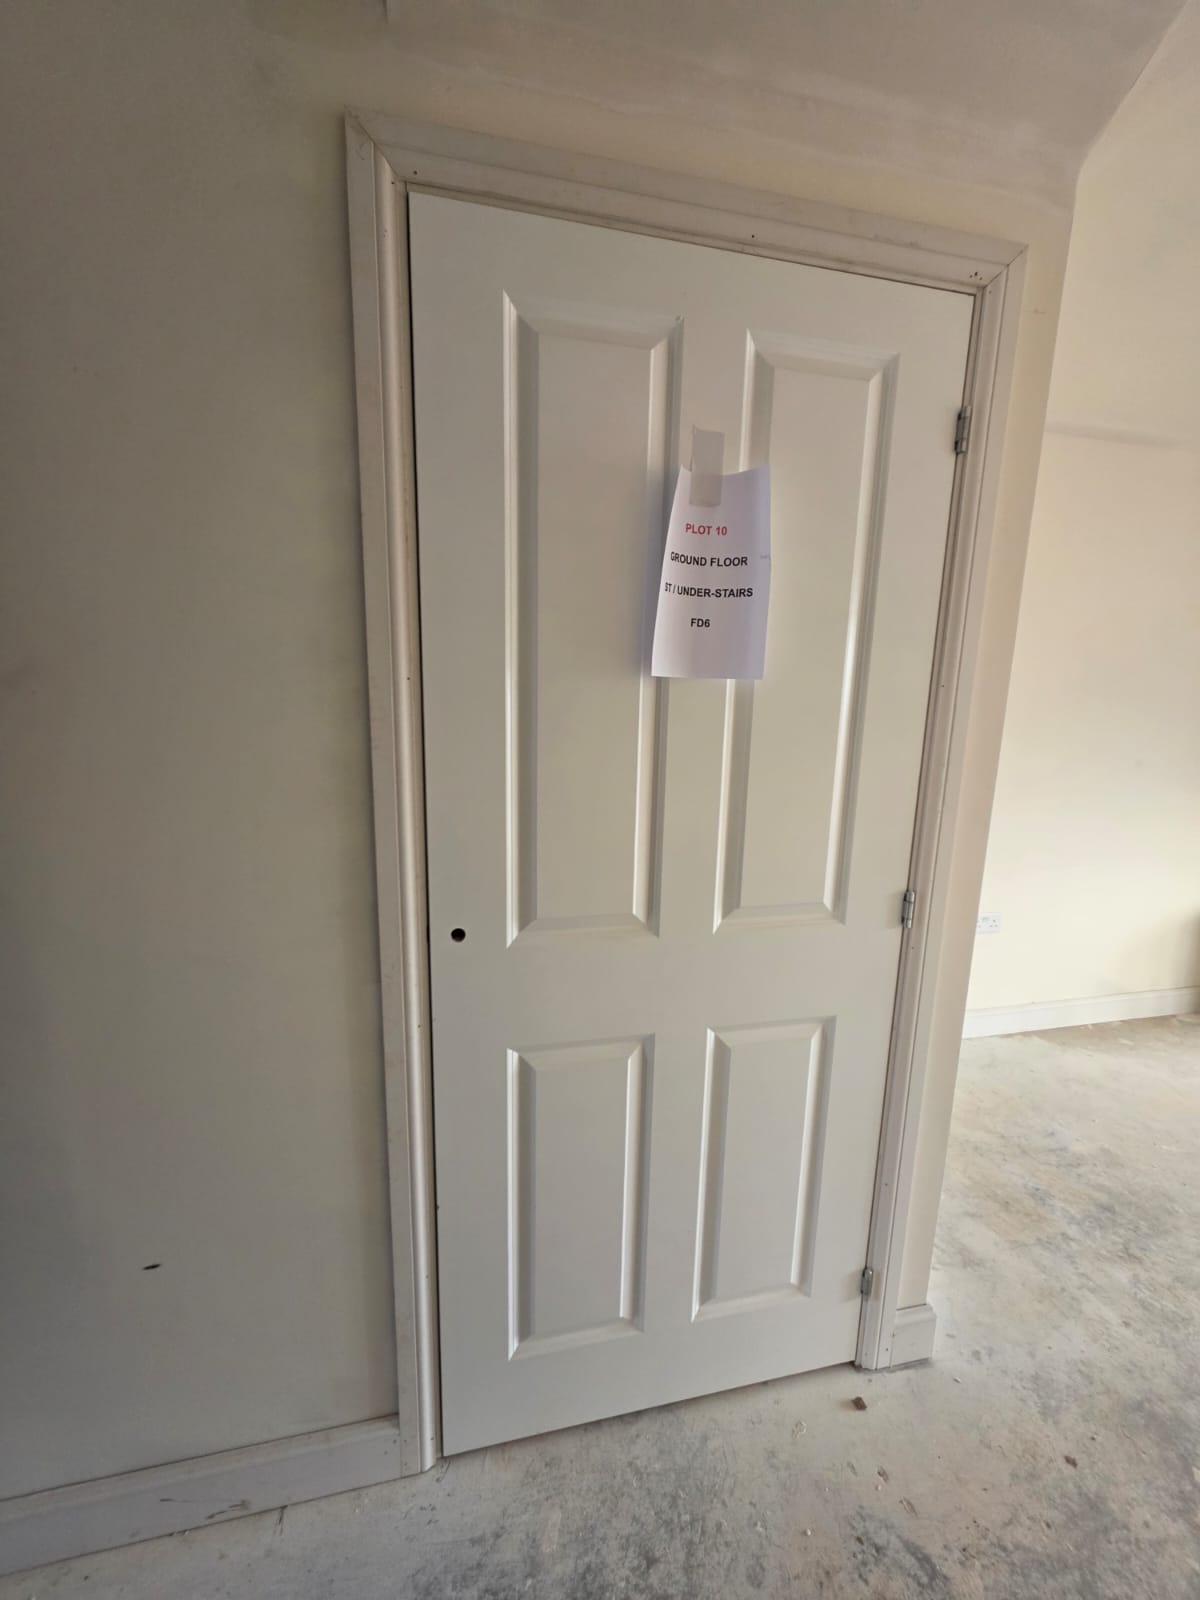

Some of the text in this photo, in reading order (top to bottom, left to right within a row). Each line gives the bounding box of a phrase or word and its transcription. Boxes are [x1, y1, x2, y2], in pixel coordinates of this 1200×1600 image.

[685, 523, 728, 536] PLOT 10
[670, 551, 748, 567] GROUND FLOOR
[677, 586, 753, 598] UNDER-STAIRS
[690, 617, 710, 628] FD6
